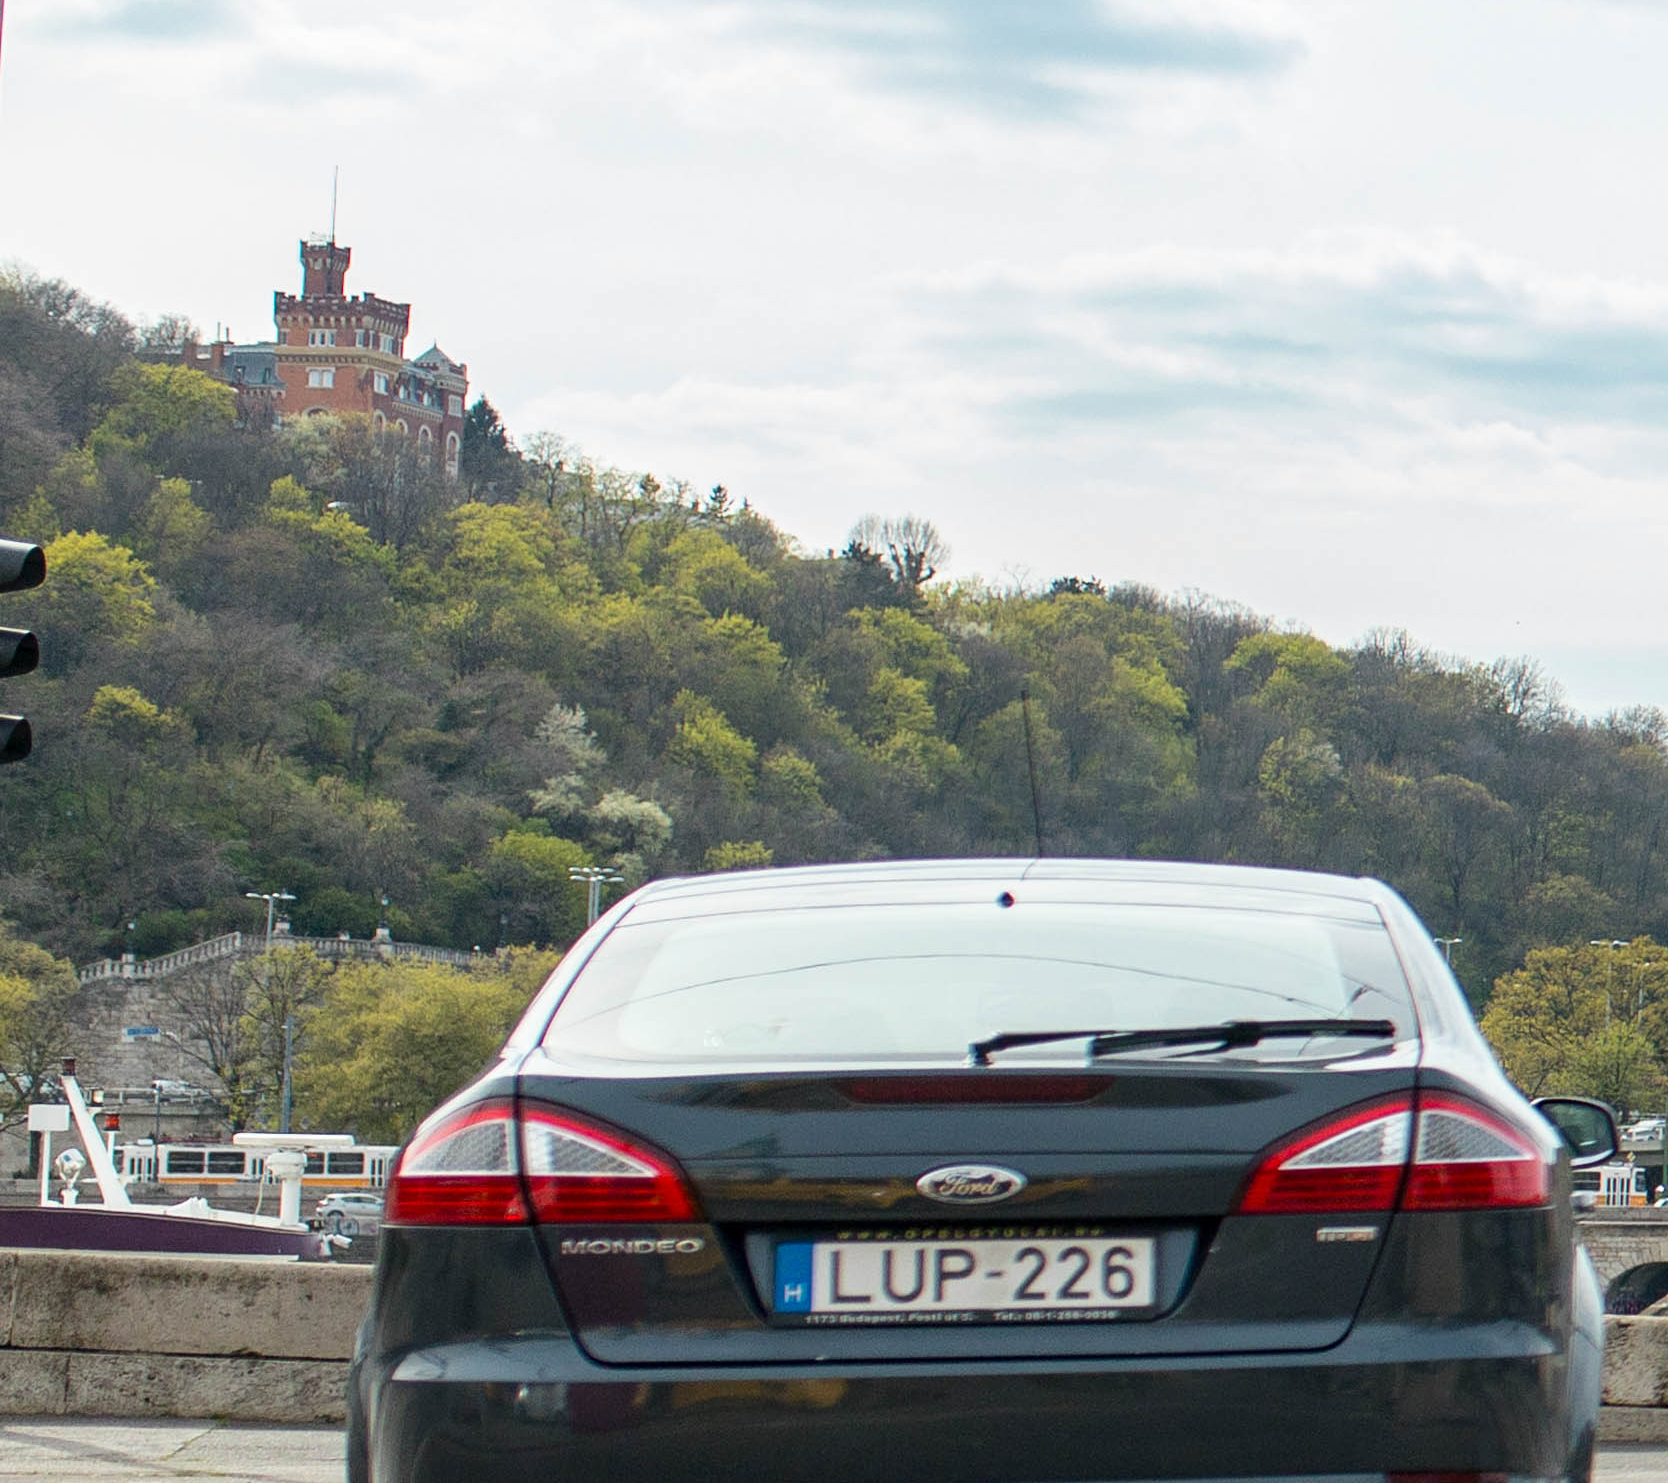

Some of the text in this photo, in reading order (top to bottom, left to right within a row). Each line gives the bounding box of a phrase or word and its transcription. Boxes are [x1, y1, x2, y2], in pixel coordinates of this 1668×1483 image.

[939, 1172, 999, 1196] Ford
[560, 1237, 704, 1255] MONDEO
[829, 1246, 1135, 1304] LUP-226
[783, 1284, 803, 1302] H
